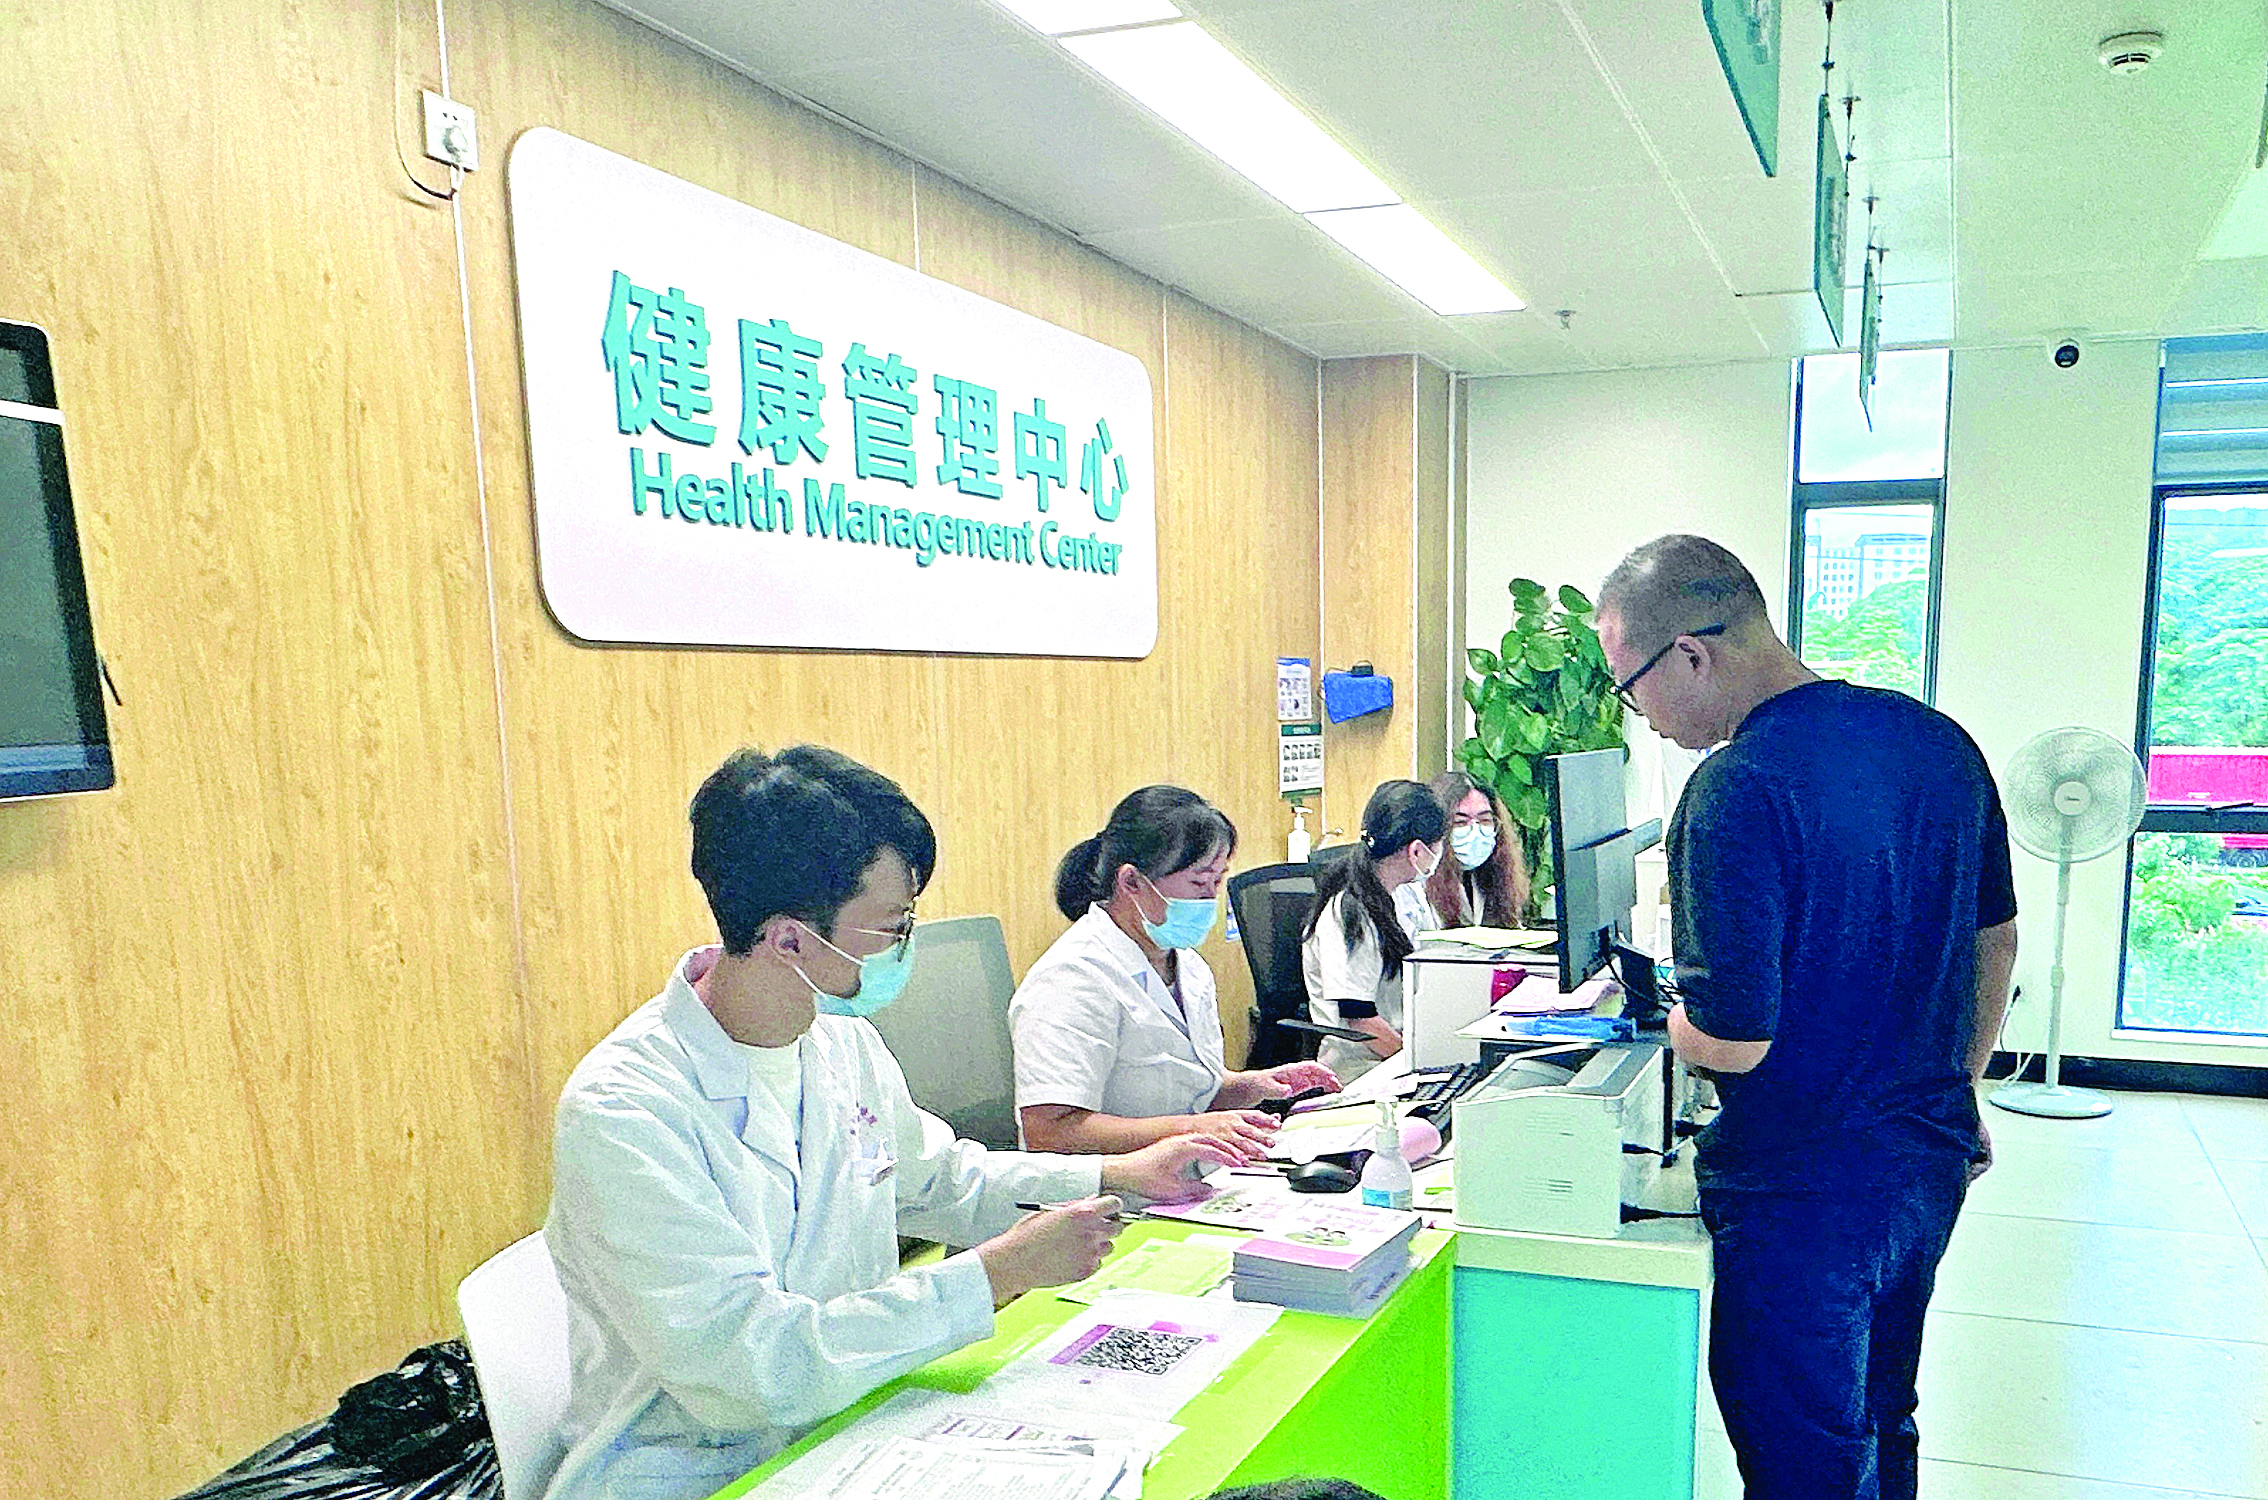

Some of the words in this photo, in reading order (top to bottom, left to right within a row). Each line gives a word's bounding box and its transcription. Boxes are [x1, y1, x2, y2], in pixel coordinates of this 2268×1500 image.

[601, 269, 1130, 524] 健康管理中心
[630, 446, 794, 535] Health
[803, 477, 1036, 568] Management
[1039, 520, 1123, 576] Center
